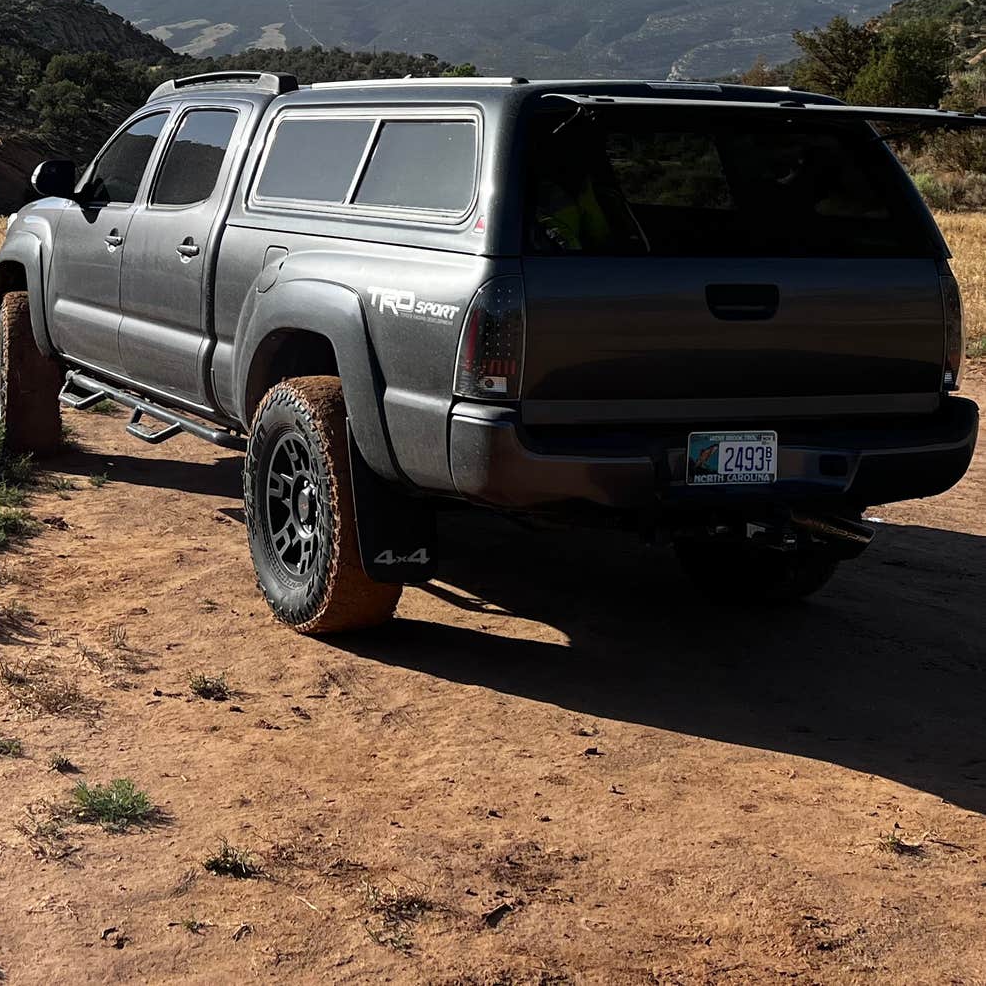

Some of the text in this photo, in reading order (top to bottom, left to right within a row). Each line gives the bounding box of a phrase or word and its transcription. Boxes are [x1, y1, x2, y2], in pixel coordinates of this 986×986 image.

[366, 286, 415, 316] TRD
[414, 301, 460, 320] SPORT
[724, 446, 765, 472] 2493
[694, 473, 770, 483] NORTH CAROLINA
[374, 548, 430, 564] 4x4
